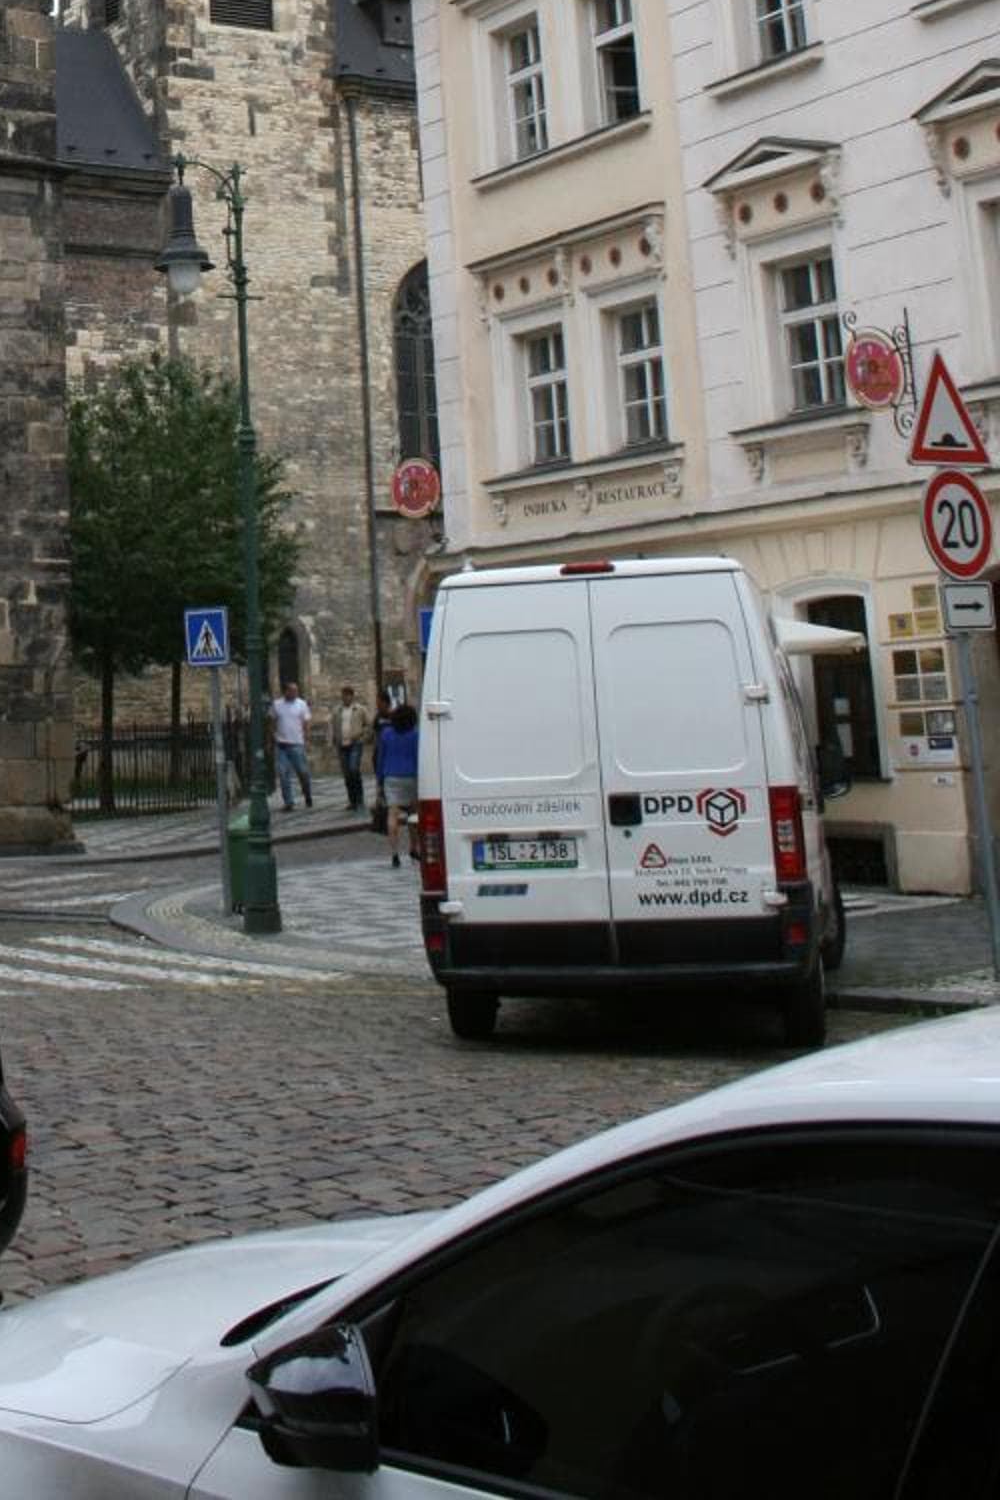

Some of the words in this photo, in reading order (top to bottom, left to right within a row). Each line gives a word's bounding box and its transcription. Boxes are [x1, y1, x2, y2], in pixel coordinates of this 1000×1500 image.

[937, 499, 979, 549] 20
[644, 796, 693, 814] DPD
[489, 844, 516, 860] 1SL
[638, 888, 749, 907] www.dpd.cz
